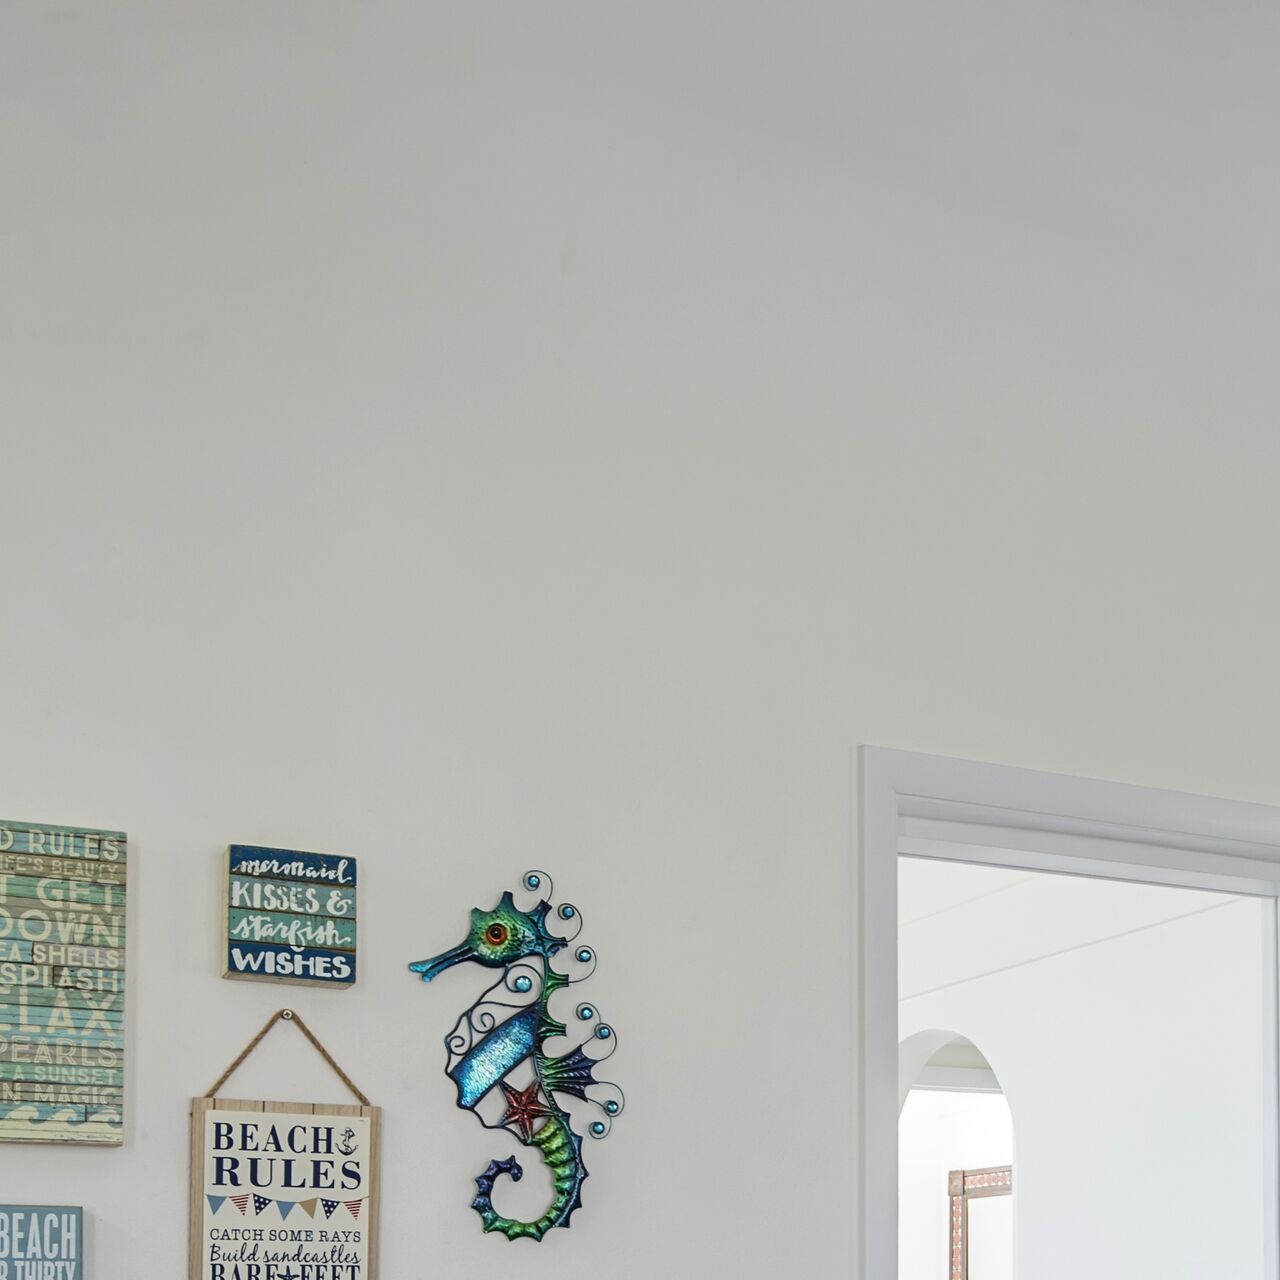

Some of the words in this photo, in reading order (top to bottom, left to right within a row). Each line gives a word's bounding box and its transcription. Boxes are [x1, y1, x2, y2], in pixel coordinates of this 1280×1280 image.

[29, 829, 119, 860] RULES
[52, 860, 118, 879] BEAUTY
[232, 859, 352, 883] mermaid
[36, 876, 121, 913] GET
[232, 881, 319, 913] KISSES
[326, 891, 352, 915] &
[231, 915, 351, 952] starfish
[33, 944, 119, 968] SHELLS
[232, 948, 351, 978] WISHES
[0, 963, 118, 989] SPLASH
[13, 1066, 24, 1080] A
[34, 1066, 116, 1085] SUNSET
[34, 1085, 117, 1107] MAGIC
[212, 1122, 335, 1154] BEACH
[212, 1156, 361, 1190] RULES
[210, 1229, 264, 1241] CATCH
[269, 1230, 313, 1242] SOME
[319, 1231, 361, 1242] RAYS
[210, 1243, 260, 1262] Build
[263, 1243, 361, 1263] sandcastles
